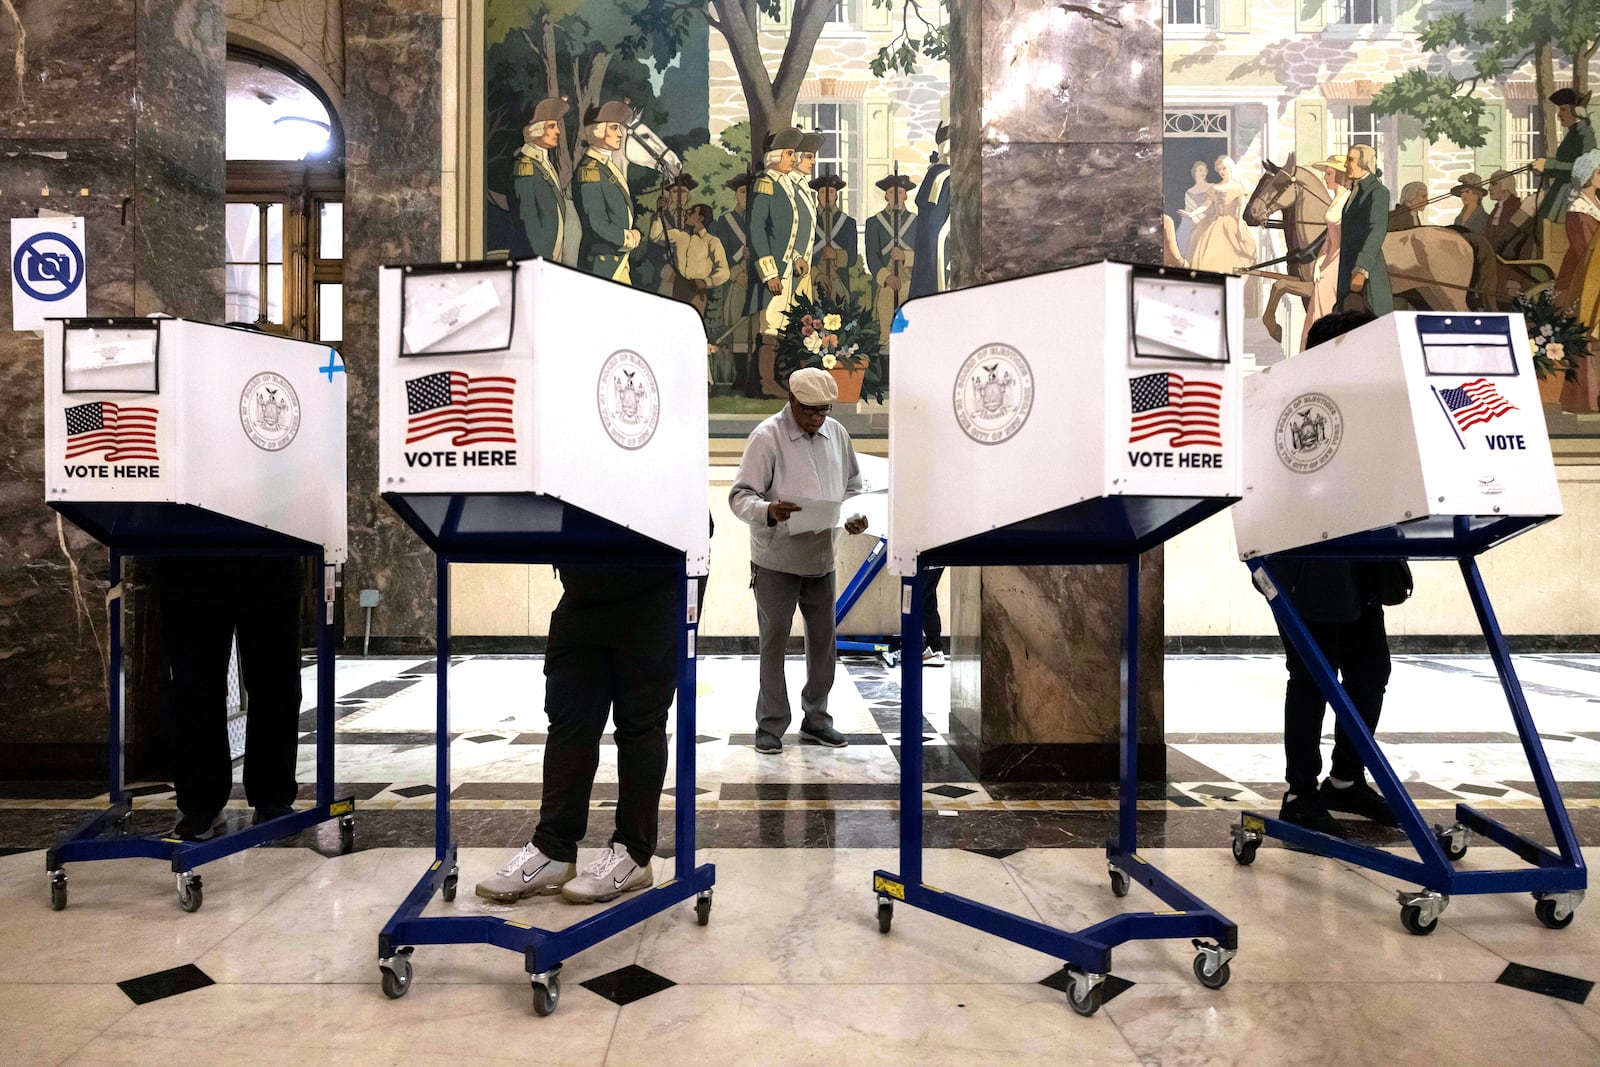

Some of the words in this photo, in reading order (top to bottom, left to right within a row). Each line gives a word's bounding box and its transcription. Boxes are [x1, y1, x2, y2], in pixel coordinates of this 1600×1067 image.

[1485, 434, 1526, 450] VOTE
[404, 451, 456, 468] VOTE
[464, 450, 517, 466] HERE
[1128, 451, 1174, 468] VOTE
[1179, 452, 1223, 468] HERE
[64, 465, 109, 478] VOTE
[114, 465, 160, 478] HERE
